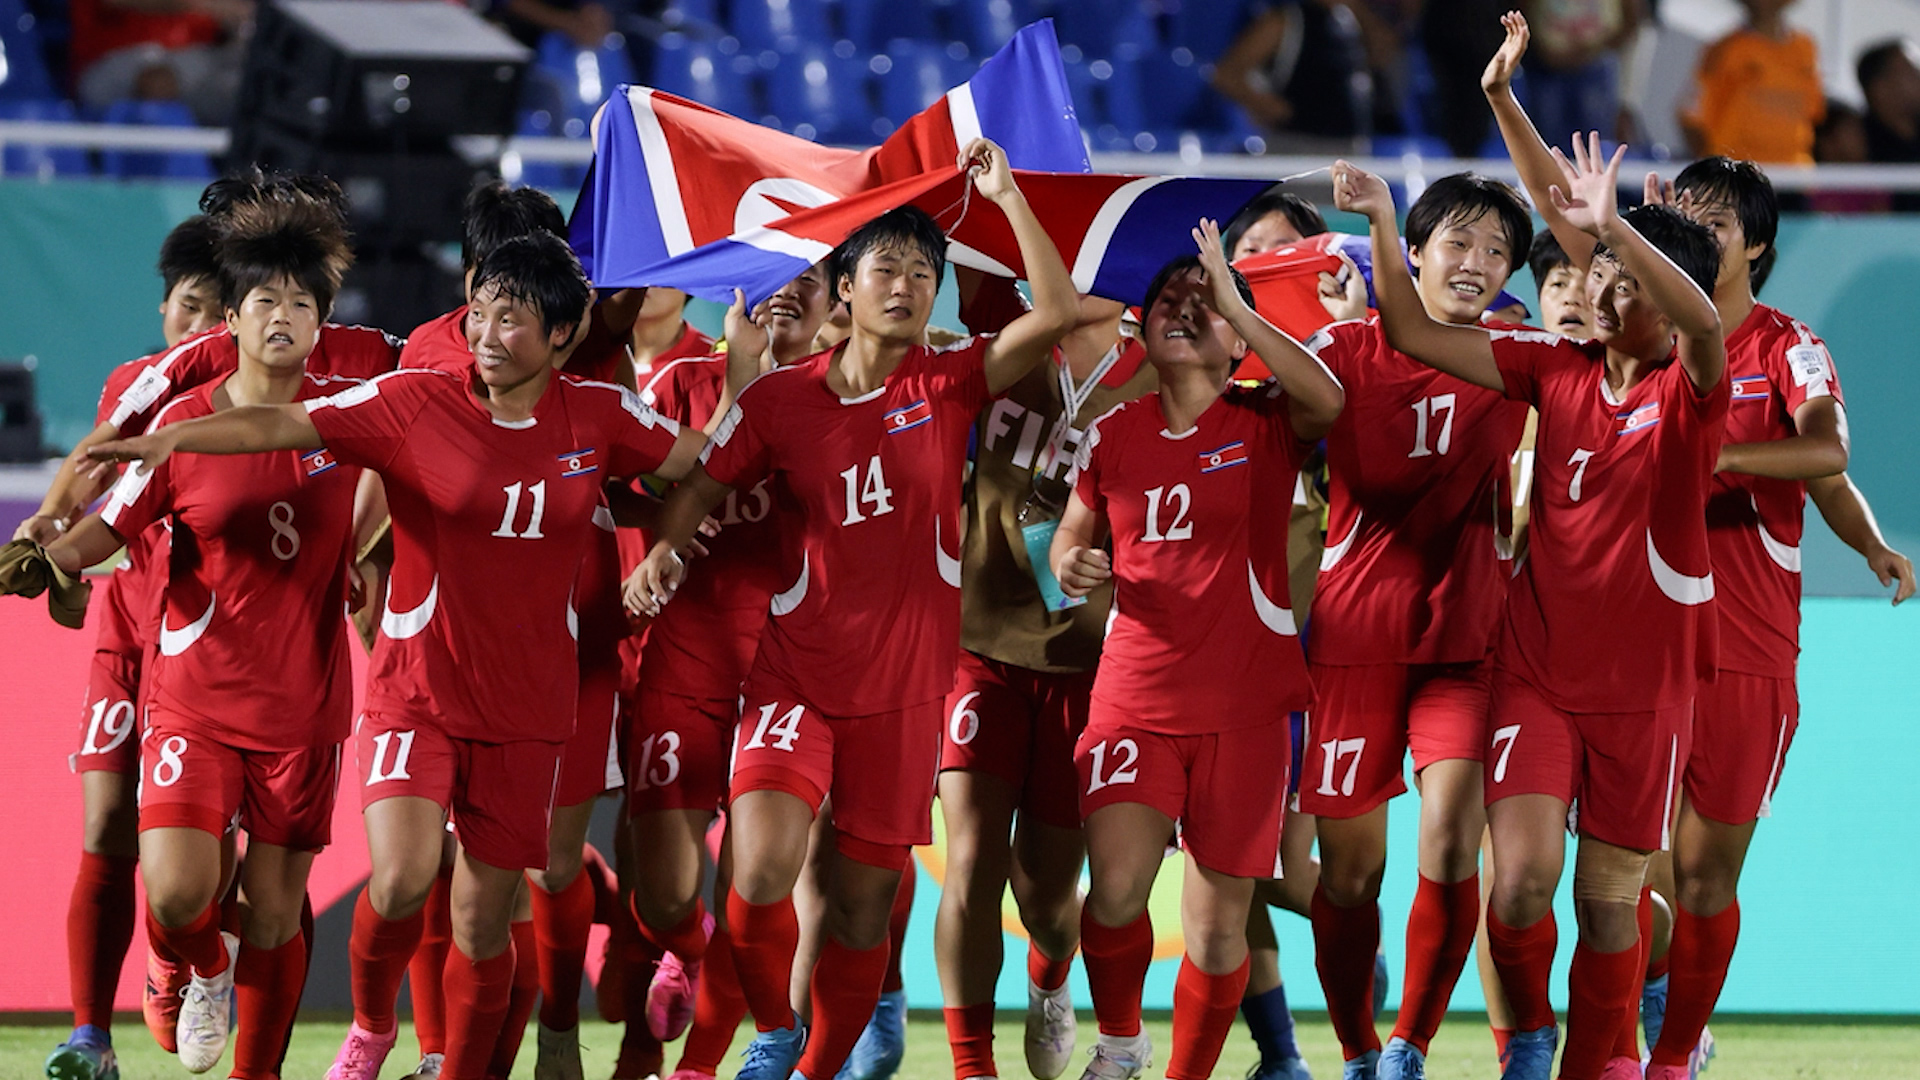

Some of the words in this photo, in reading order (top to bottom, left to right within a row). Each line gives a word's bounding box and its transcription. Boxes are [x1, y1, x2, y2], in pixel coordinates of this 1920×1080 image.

[984, 397, 1085, 481] FIF
[1407, 393, 1456, 458] 17
[840, 455, 894, 527] 14
[1567, 448, 1595, 502] 7
[268, 501, 300, 561] 8
[491, 479, 545, 539] 11
[1140, 483, 1193, 542] 12
[80, 697, 135, 756] 19
[742, 701, 806, 753] 14
[949, 691, 979, 745] 6
[152, 735, 188, 787] 8
[365, 729, 415, 787] 11
[634, 730, 681, 792] 13
[1087, 738, 1139, 795] 12
[1316, 736, 1366, 797] 17
[1492, 724, 1521, 783] 7
